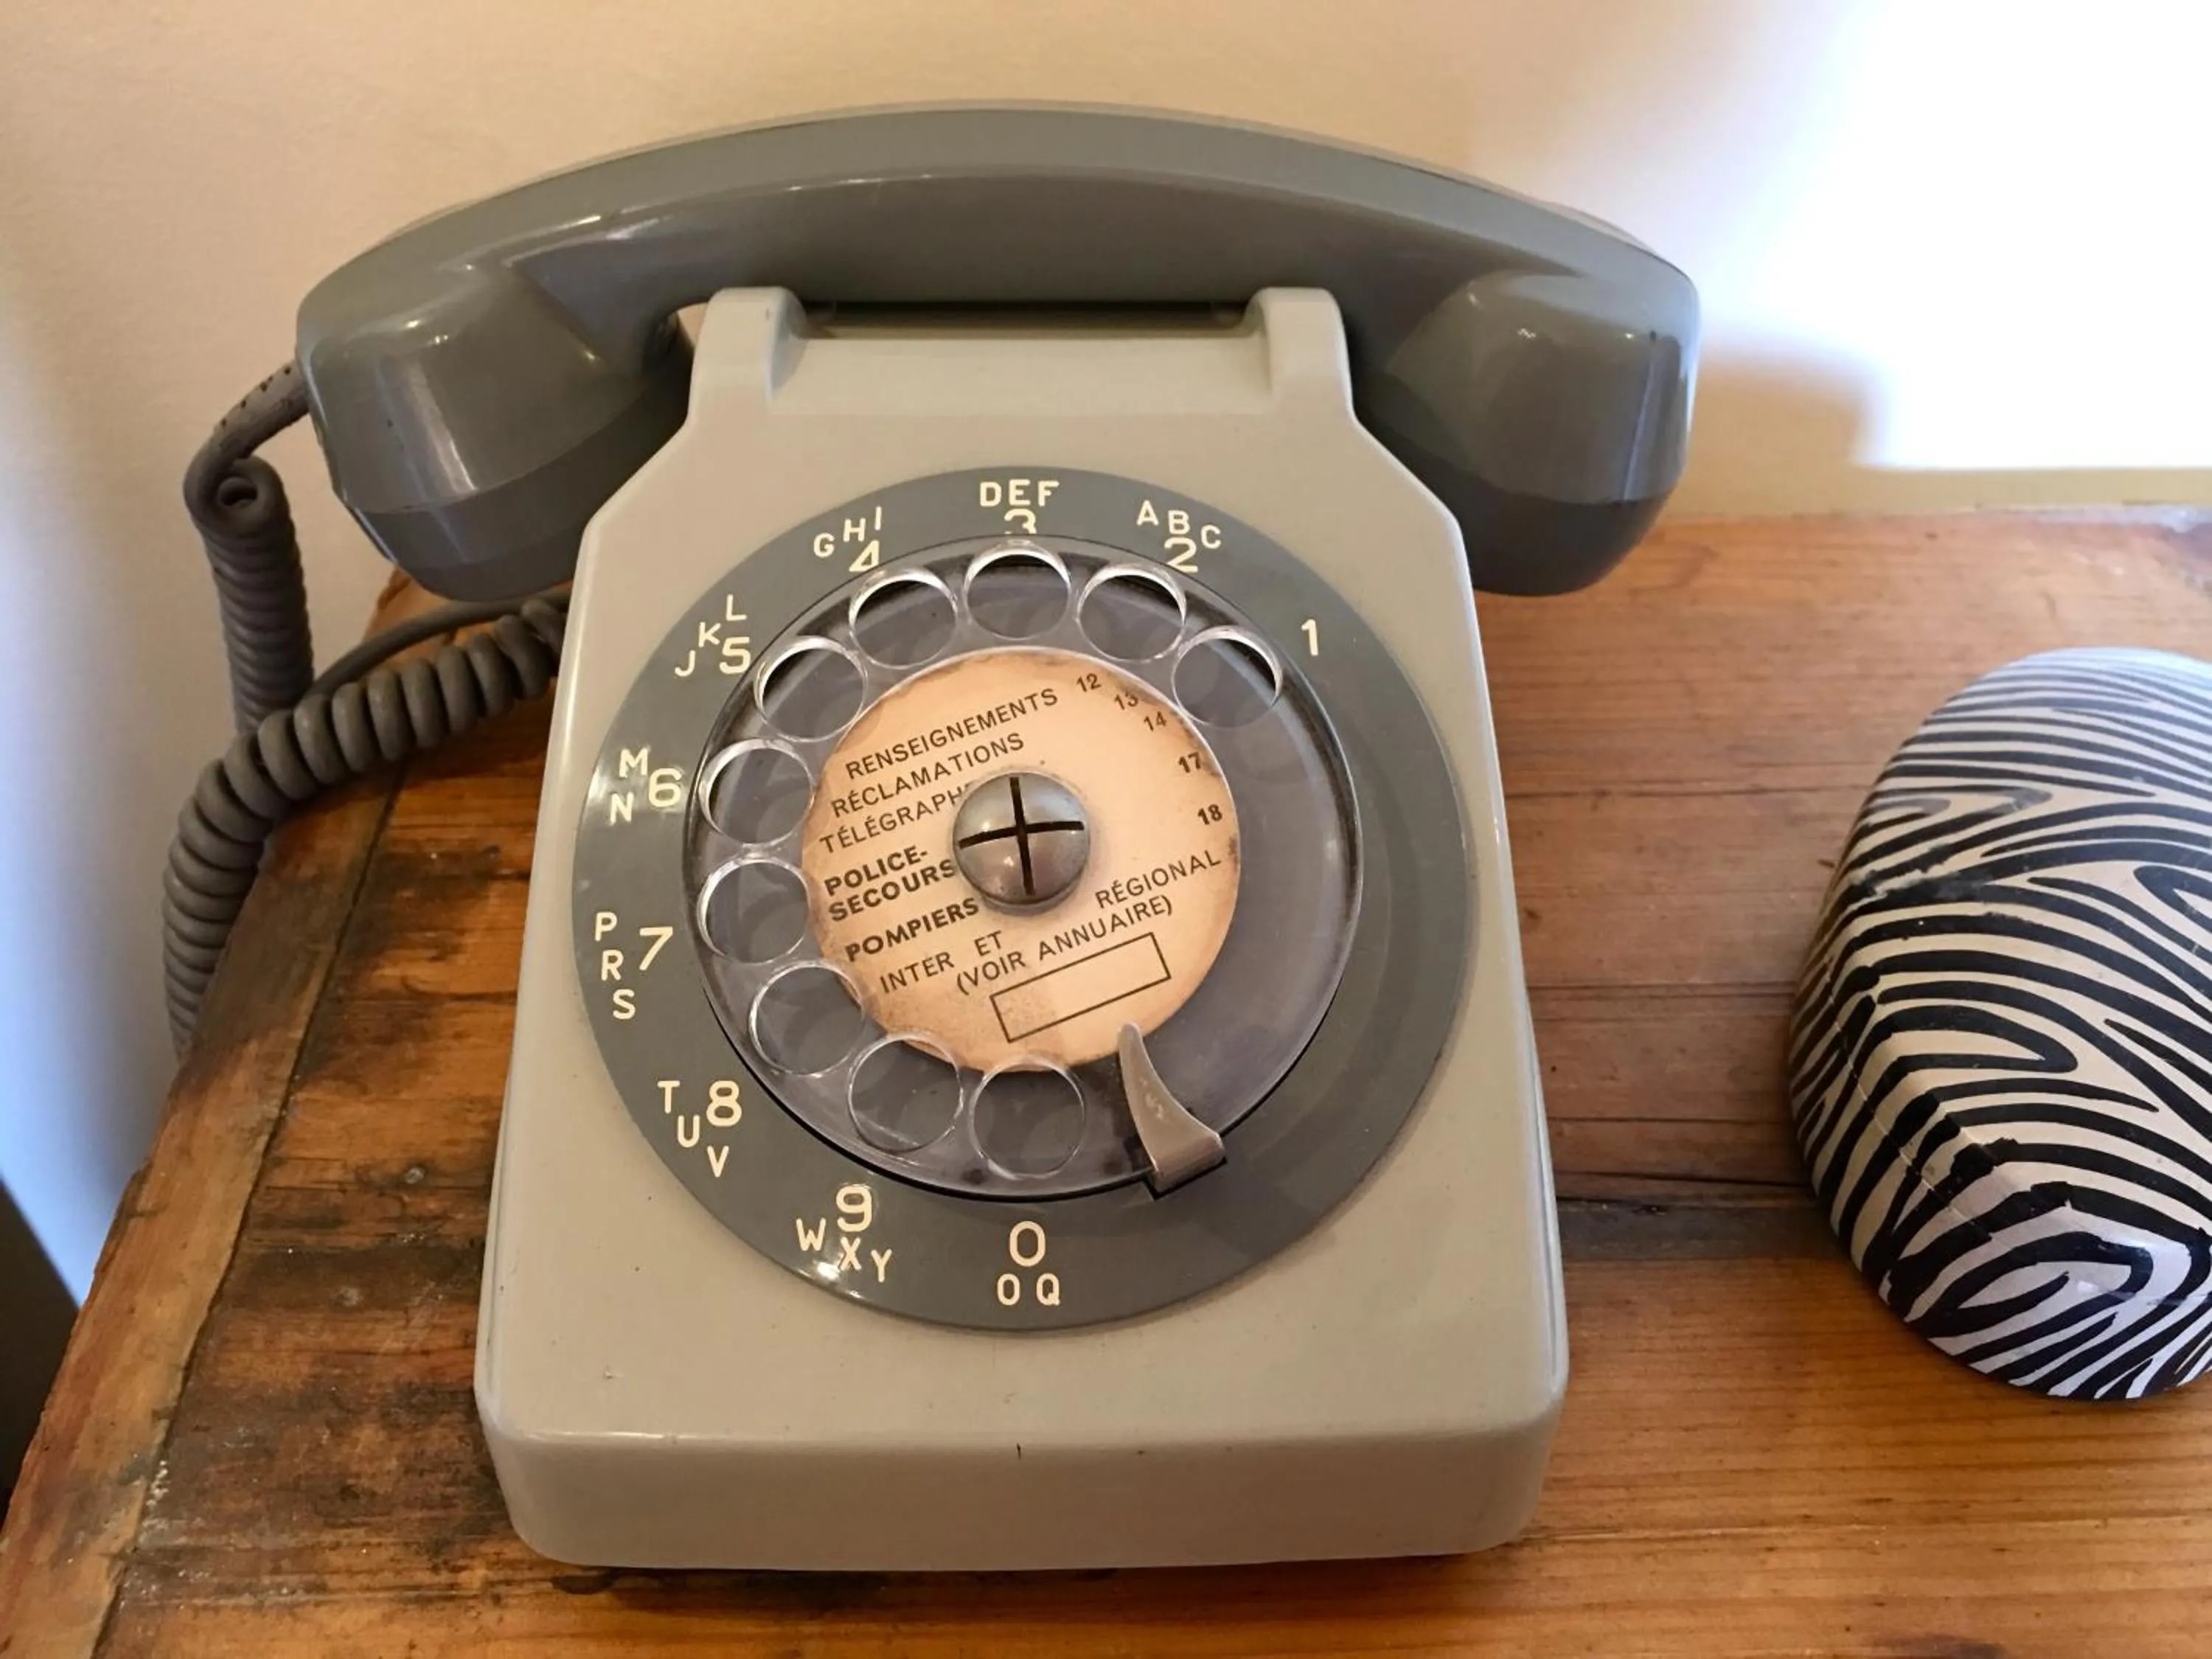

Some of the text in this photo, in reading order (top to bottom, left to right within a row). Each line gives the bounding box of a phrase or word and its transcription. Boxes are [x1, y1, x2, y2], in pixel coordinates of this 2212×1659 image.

[979, 479, 1060, 507] DEF
[1136, 501, 1222, 550] ABC
[849, 539, 880, 572] 4
[1165, 536, 1198, 572] 2
[719, 636, 751, 674] 5
[1301, 619, 1320, 656] 1
[845, 672, 1102, 780] RENSEIGNEMENTS 12
[830, 693, 1140, 818] RÉCLAMATIONS 13
[648, 768, 683, 808] 6
[819, 712, 1168, 855] TÉLÉGRAPH 14
[827, 751, 1203, 922] SECOURS 17
[824, 845, 929, 897] POLICE-
[844, 804, 1224, 962] POMPIERS 18
[879, 849, 1222, 994] INTER ET RÉGIONAL
[956, 894, 1173, 995] (VOIR ANNUAIRE)
[639, 926, 673, 972] 7
[706, 1079, 742, 1127] 8
[835, 1183, 874, 1233] 9
